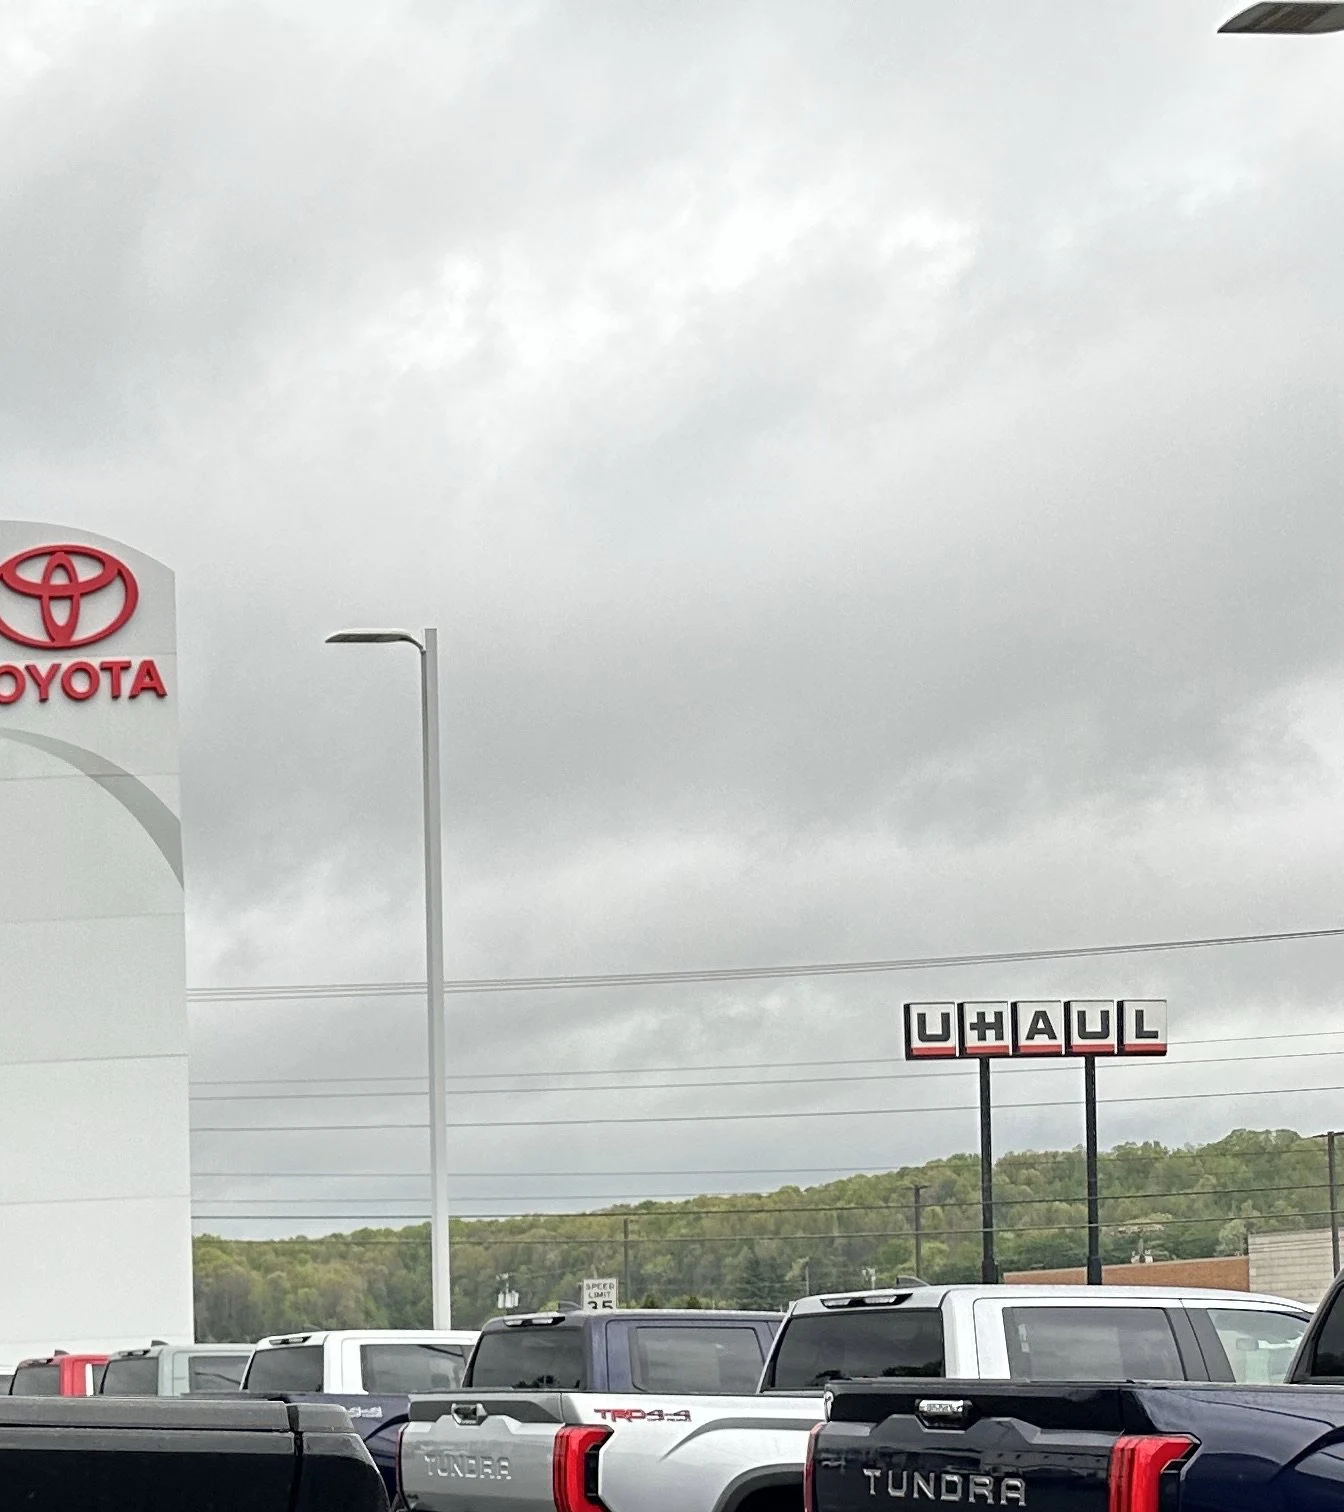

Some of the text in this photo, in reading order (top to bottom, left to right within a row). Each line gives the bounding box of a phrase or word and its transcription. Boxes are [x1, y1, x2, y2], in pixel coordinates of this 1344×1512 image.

[585, 1282, 615, 1291] SPEED
[588, 1291, 611, 1299] LIMIT
[593, 1408, 646, 1423] TRD
[424, 1454, 512, 1480] TUNDRA
[862, 1467, 1028, 1507] TUNDRA
